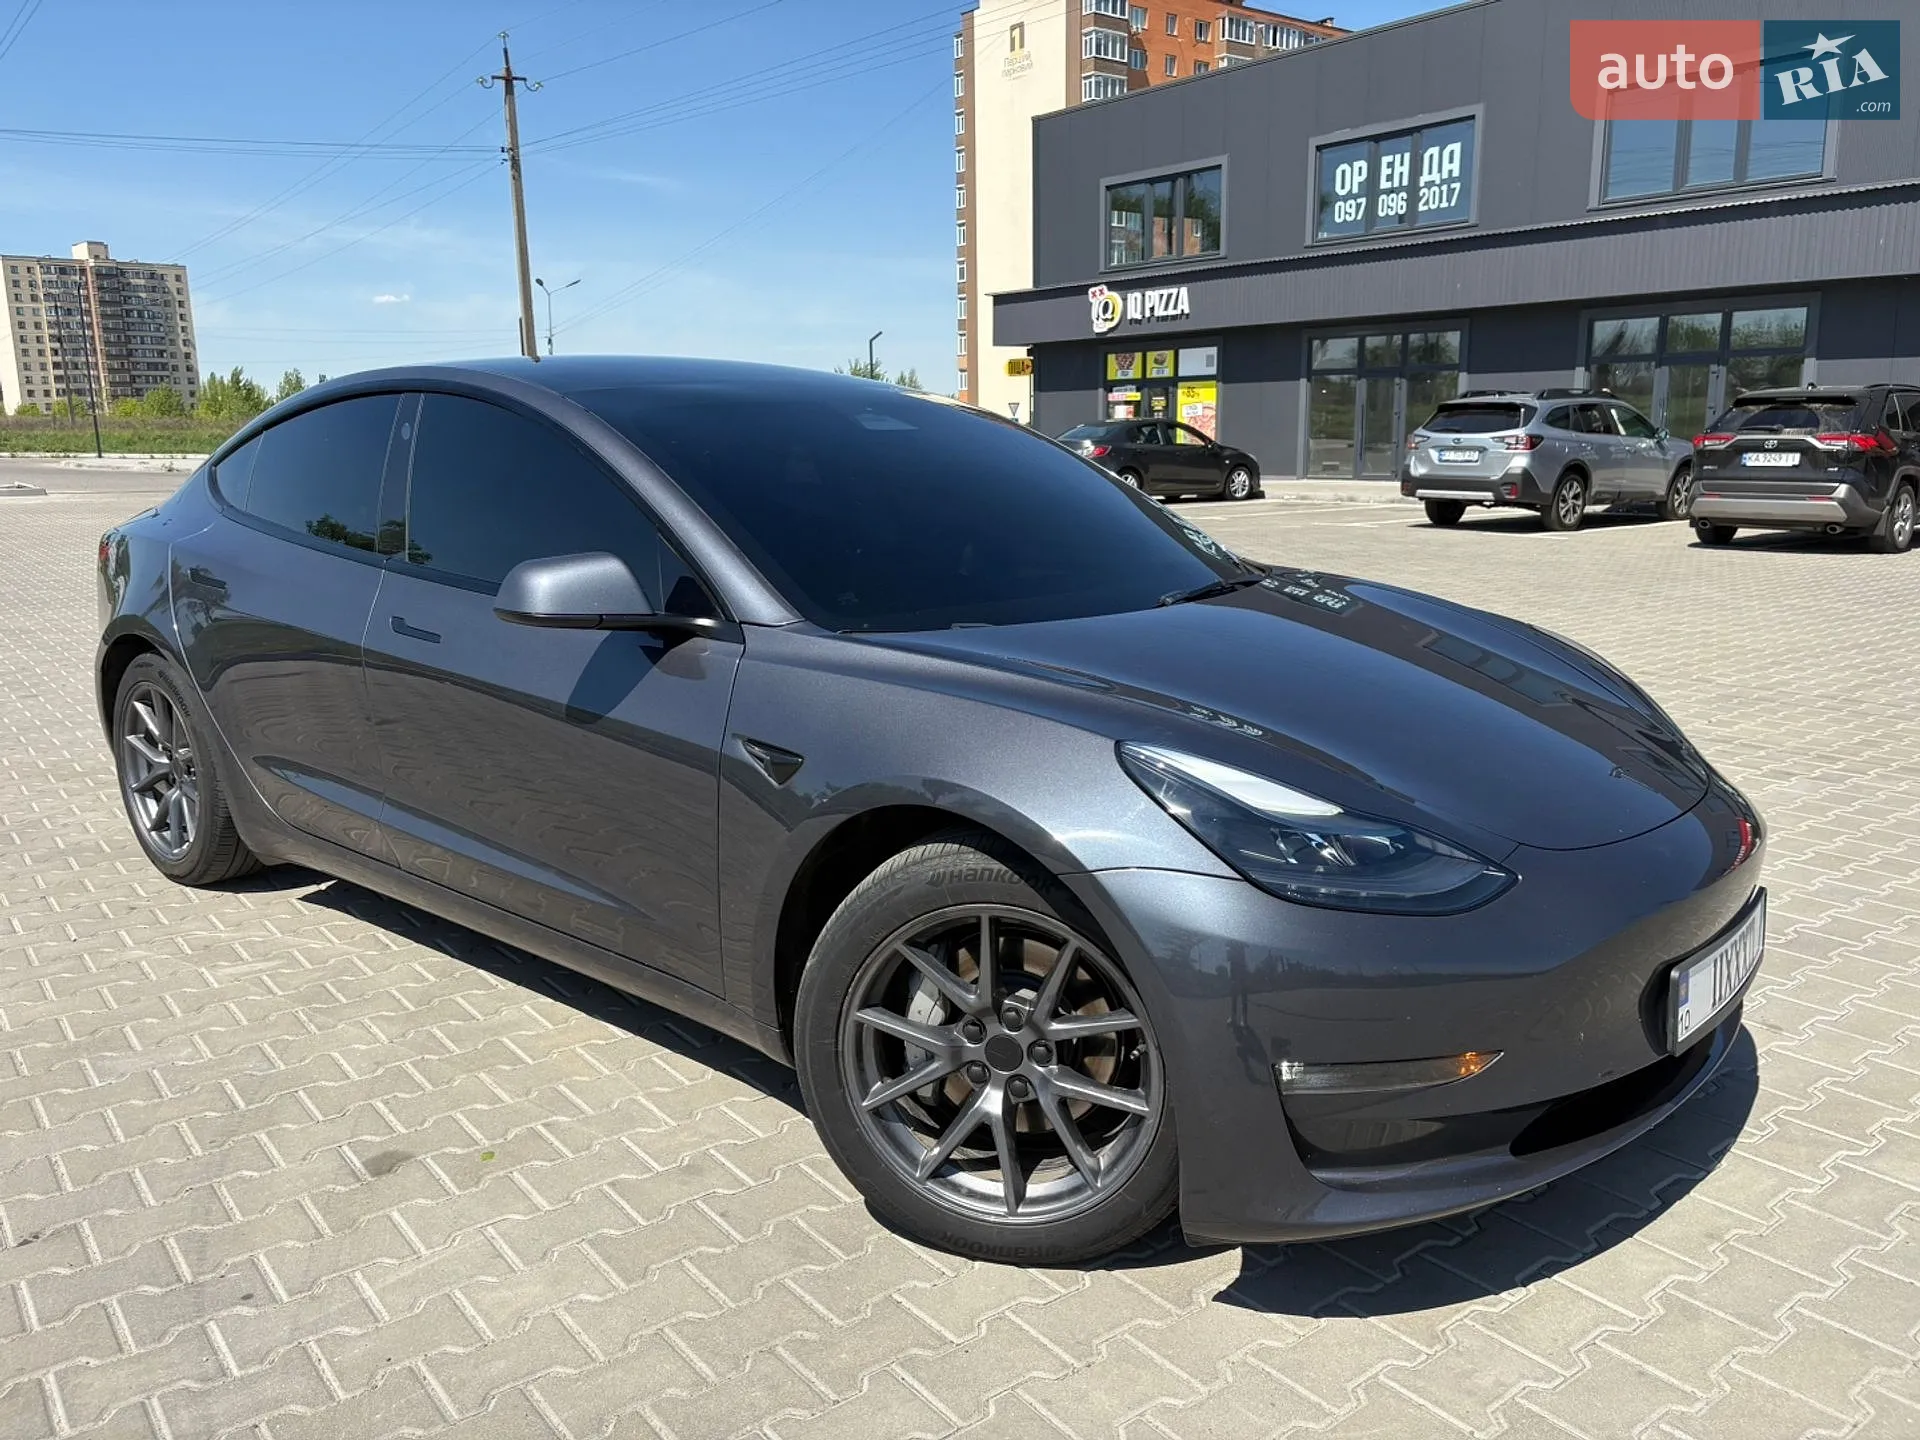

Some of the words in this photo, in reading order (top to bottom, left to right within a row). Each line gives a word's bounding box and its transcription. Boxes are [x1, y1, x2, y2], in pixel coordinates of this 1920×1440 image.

[1334, 197, 1367, 223] 097
[1377, 191, 1408, 217] 096
[1418, 183, 1461, 212] 2017
[1126, 292, 1143, 320] IQ
[1145, 287, 1190, 318] PIZZA
[1680, 1009, 1691, 1035] 10
